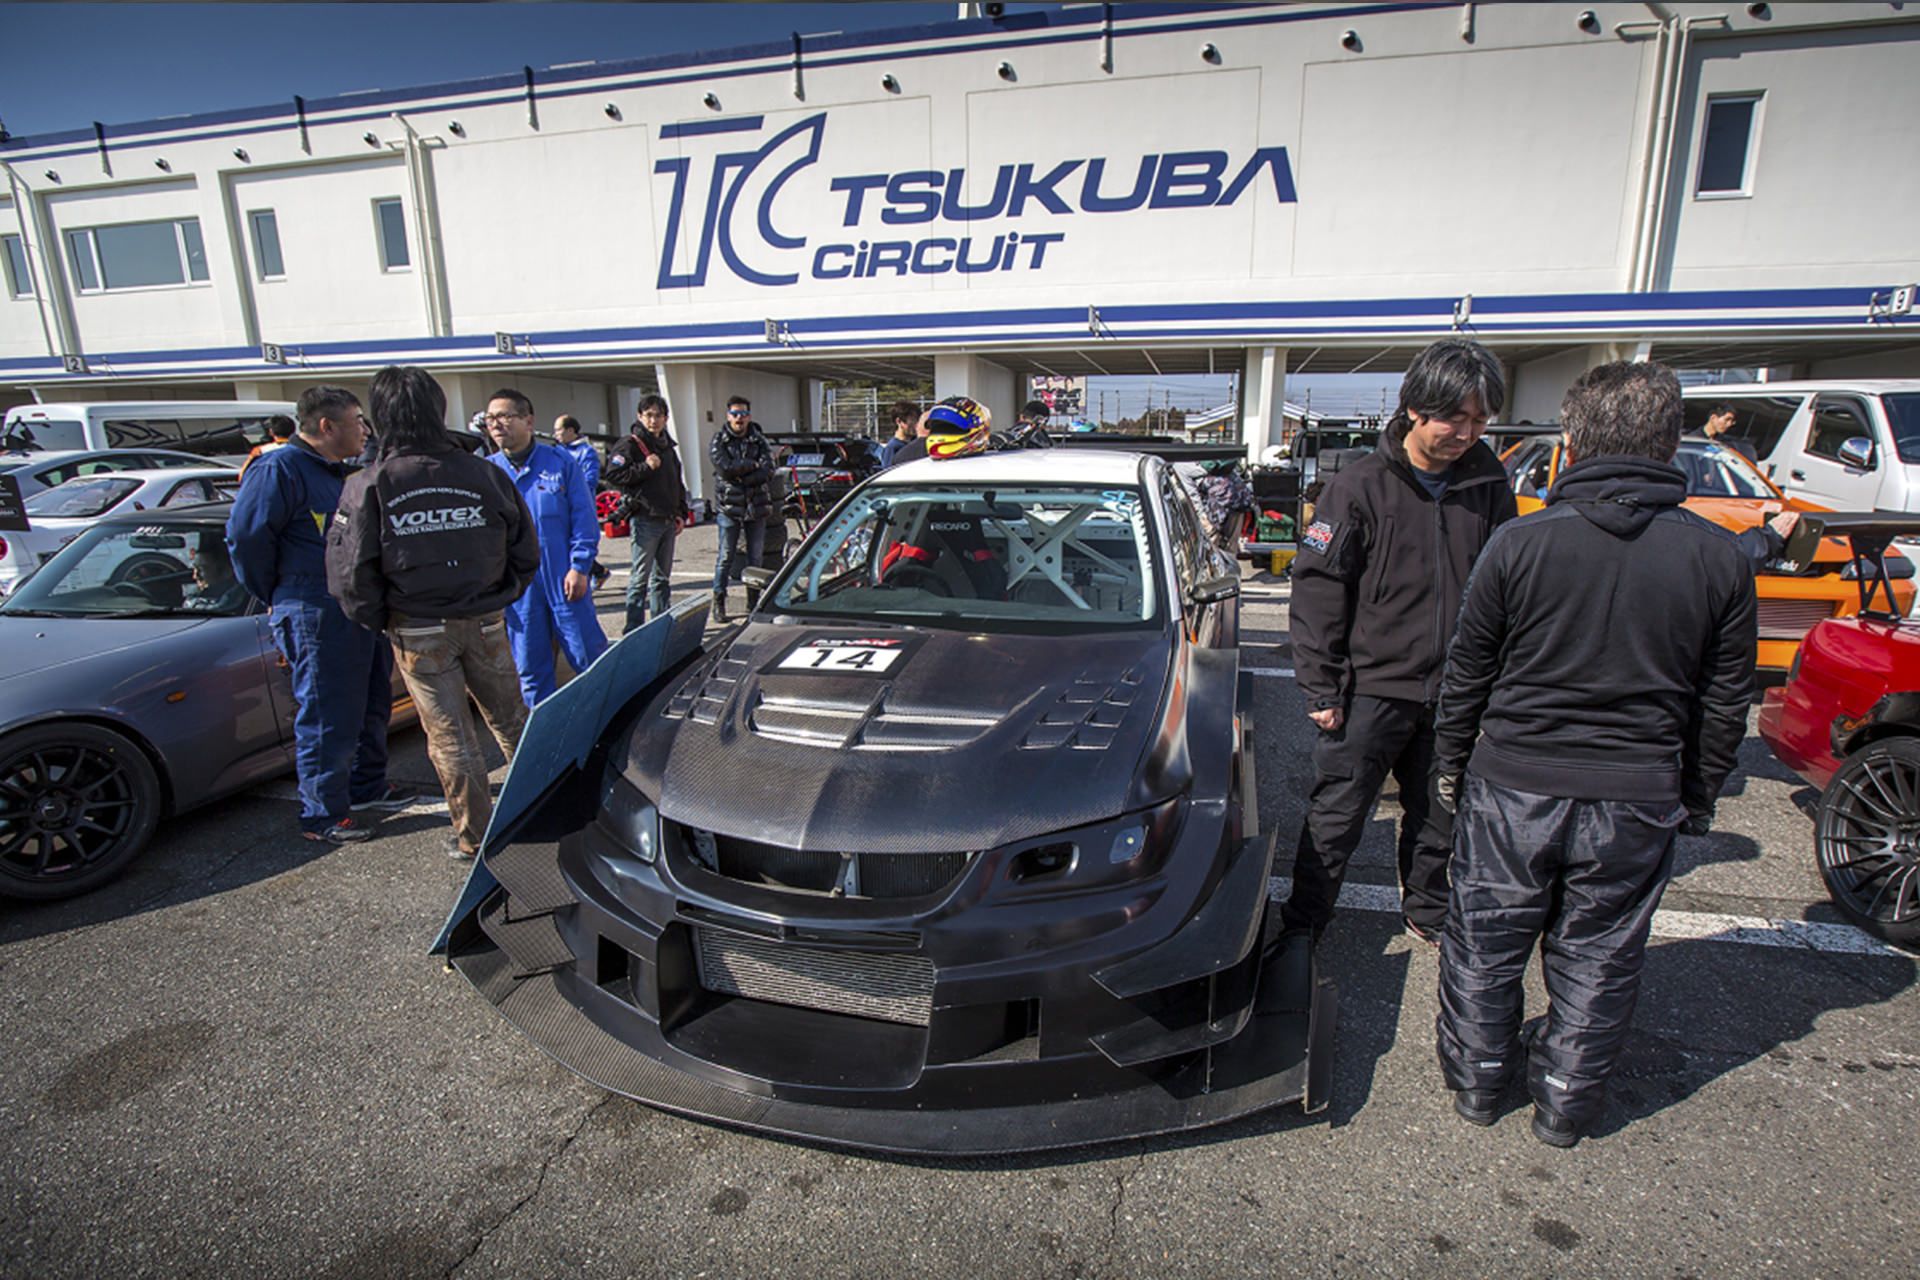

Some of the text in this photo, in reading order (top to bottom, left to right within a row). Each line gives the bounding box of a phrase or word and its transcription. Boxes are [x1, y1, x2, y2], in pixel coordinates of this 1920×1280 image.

[829, 145, 1299, 227] TSUKUBA
[654, 112, 828, 290] TC
[1896, 290, 1907, 310] 9
[269, 345, 278, 360] 3
[502, 336, 509, 350] 5
[70, 357, 80, 370] 2
[388, 505, 484, 529] VOLTEX
[929, 521, 971, 532] RECARO
[810, 648, 878, 669] 14
